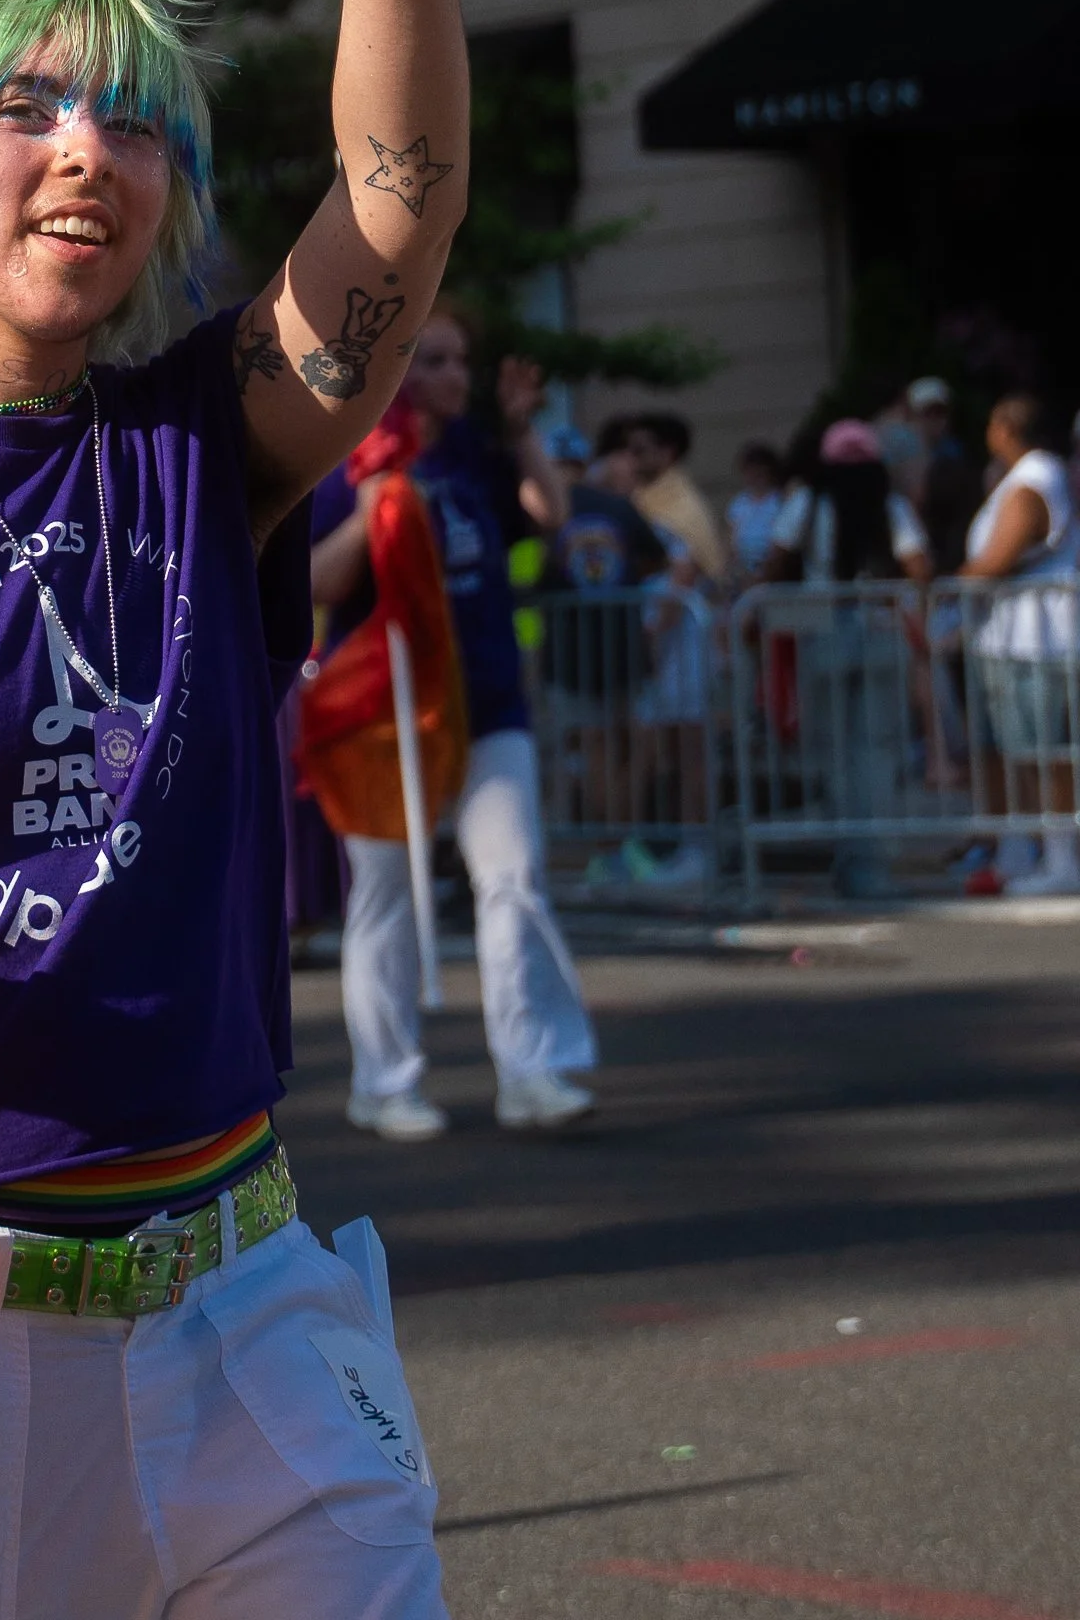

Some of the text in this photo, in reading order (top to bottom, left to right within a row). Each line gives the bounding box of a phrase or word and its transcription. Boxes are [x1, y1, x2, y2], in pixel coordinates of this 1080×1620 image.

[734, 78, 921, 129] HAMILTON
[0, 521, 86, 573] 2025
[111, 771, 129, 779] 2024
[12, 792, 124, 836] BAN
[343, 1364, 402, 1442] AMORE
